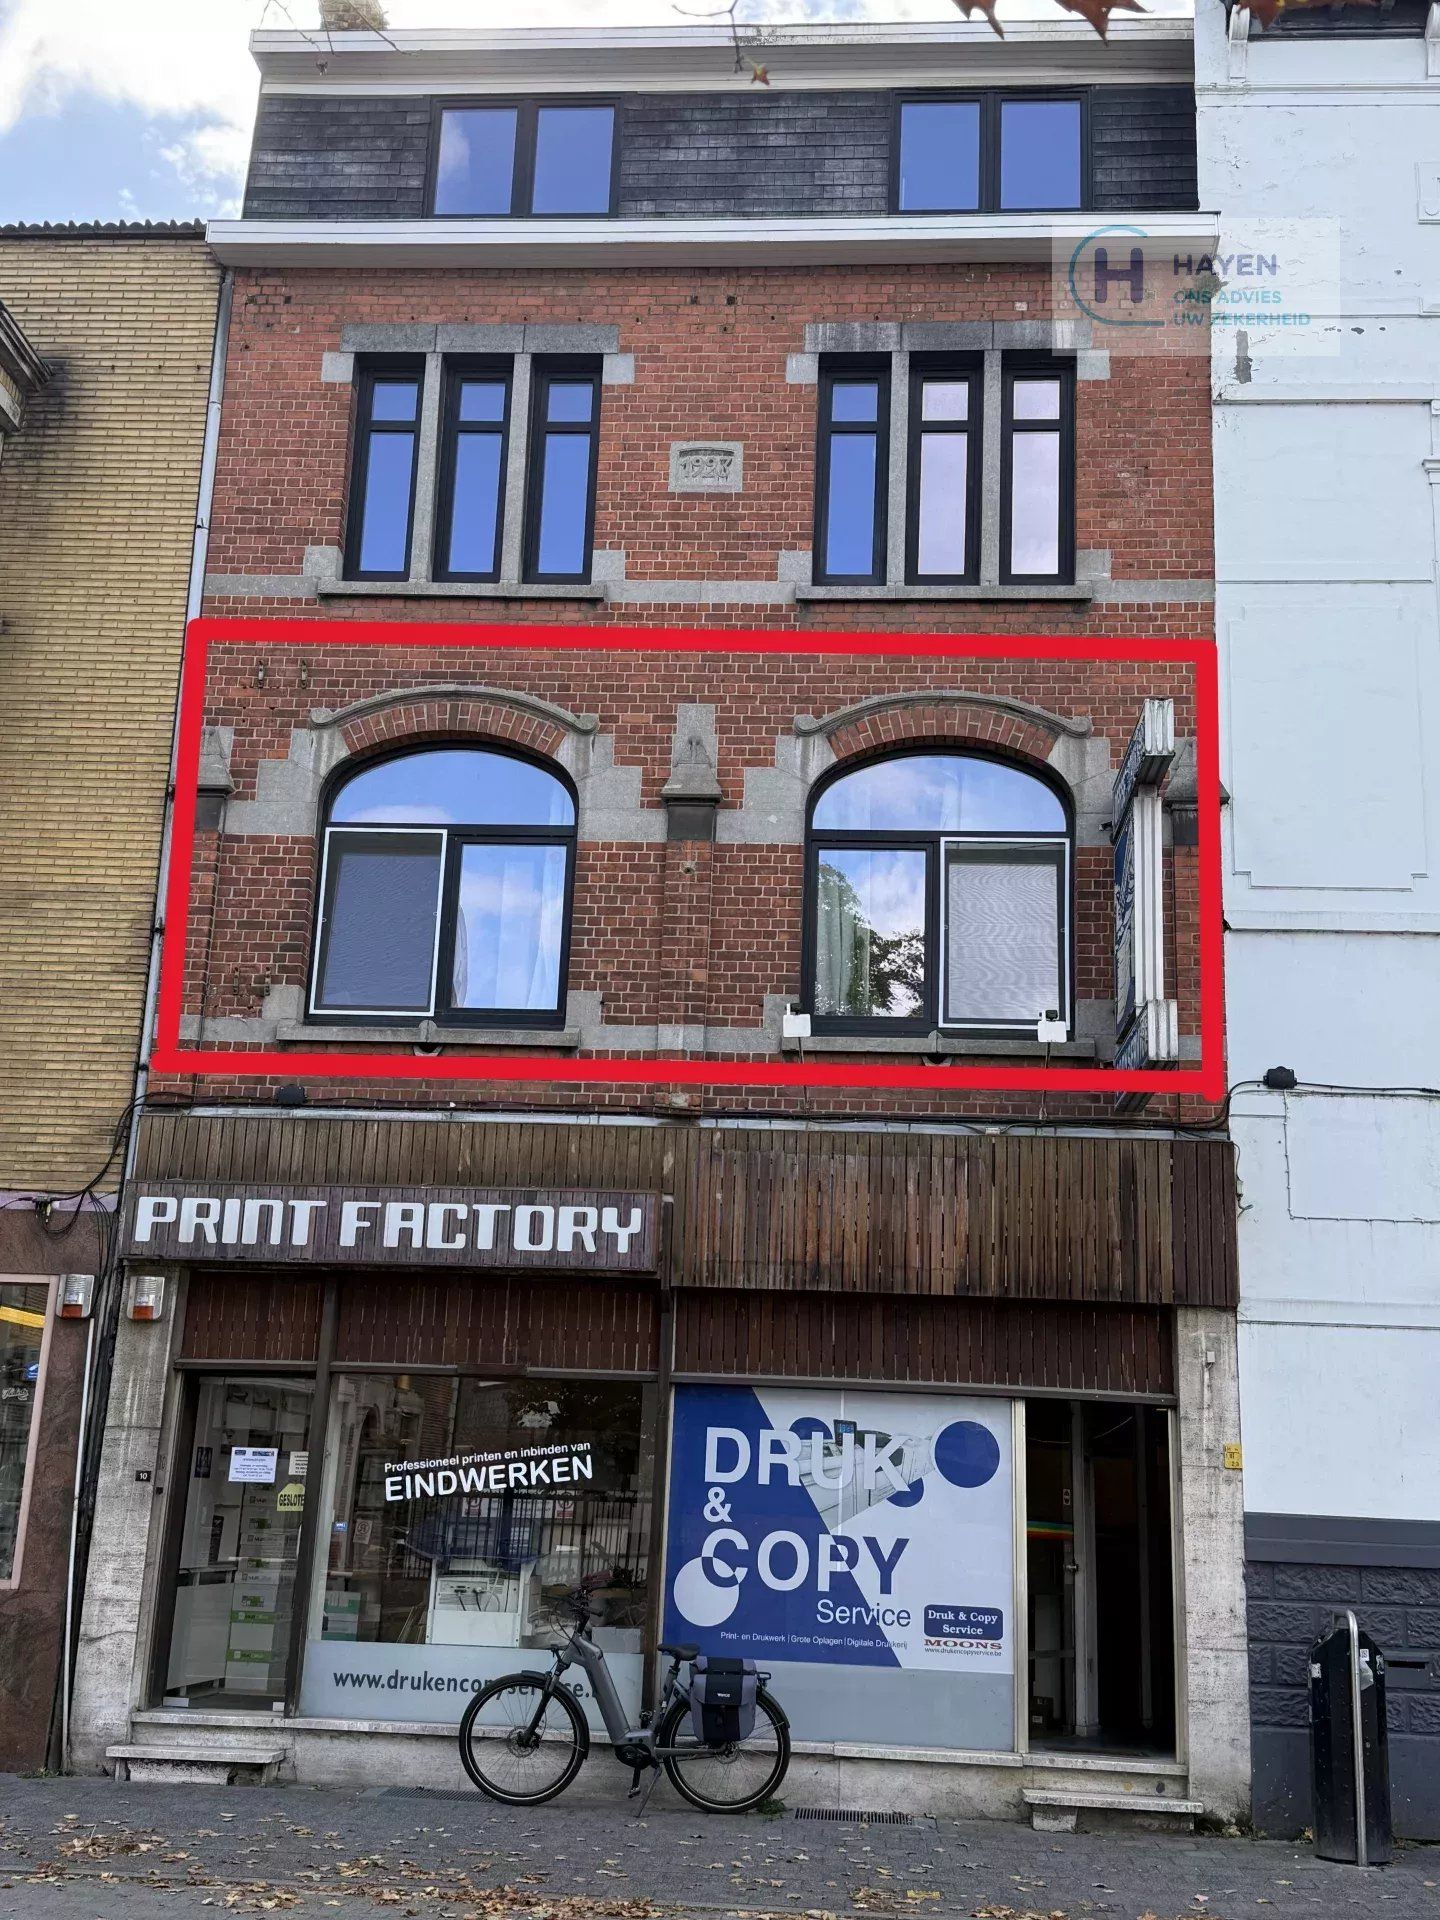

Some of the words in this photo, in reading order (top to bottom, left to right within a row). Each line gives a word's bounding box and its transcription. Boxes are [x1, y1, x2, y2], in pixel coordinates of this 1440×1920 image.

[135, 1197, 328, 1246] PRINT
[340, 1201, 642, 1254] FACTORY
[384, 1455, 459, 1473] Professioneel
[462, 1452, 501, 1466] printen
[504, 1449, 518, 1459] en
[520, 1443, 568, 1457] inbinden
[570, 1442, 591, 1452] van
[704, 1427, 911, 1492] DRUK
[139, 1472, 148, 1480] 10
[385, 1454, 593, 1502] EINDWERKEN
[703, 1487, 733, 1523] &
[701, 1528, 910, 1595] COPY
[816, 1599, 911, 1627] Service
[927, 1610, 955, 1620] Druk
[958, 1612, 967, 1620] &
[970, 1612, 998, 1625] Copy
[752, 1633, 786, 1642] Drukwerk
[791, 1635, 811, 1644] Grote
[813, 1636, 843, 1646] Oplagen
[847, 1637, 874, 1648] Digitale
[942, 1624, 983, 1635] Service
[924, 1639, 1002, 1650] MOONS
